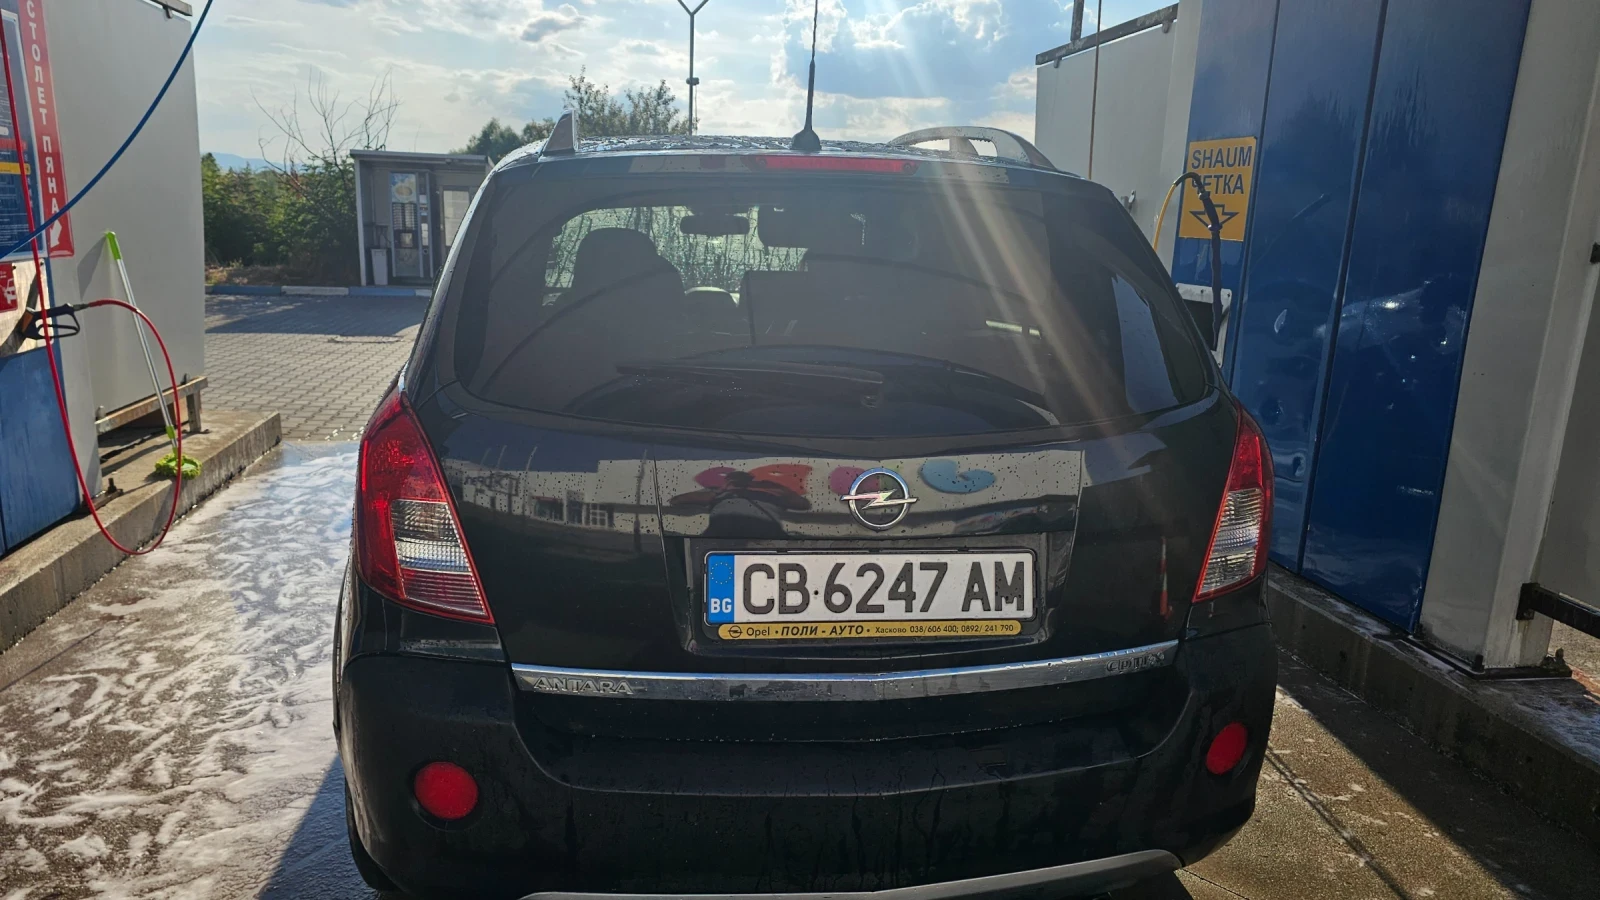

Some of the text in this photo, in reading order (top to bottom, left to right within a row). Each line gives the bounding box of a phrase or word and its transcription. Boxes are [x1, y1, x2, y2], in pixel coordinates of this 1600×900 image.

[1191, 146, 1253, 169] SHAUM
[43, 136, 60, 214] ПЯНА
[743, 561, 1025, 615] CB 6247 AM
[711, 598, 732, 613] BG
[746, 626, 770, 638] Opel
[781, 626, 818, 637] ПОЛИ
[829, 625, 864, 636] АУТО
[875, 626, 907, 634] Хасково
[909, 624, 942, 634] 038/606
[961, 624, 982, 633] 0892/
[984, 624, 998, 632] 241
[1000, 624, 1014, 632] 790
[534, 676, 633, 695] ANTARA
